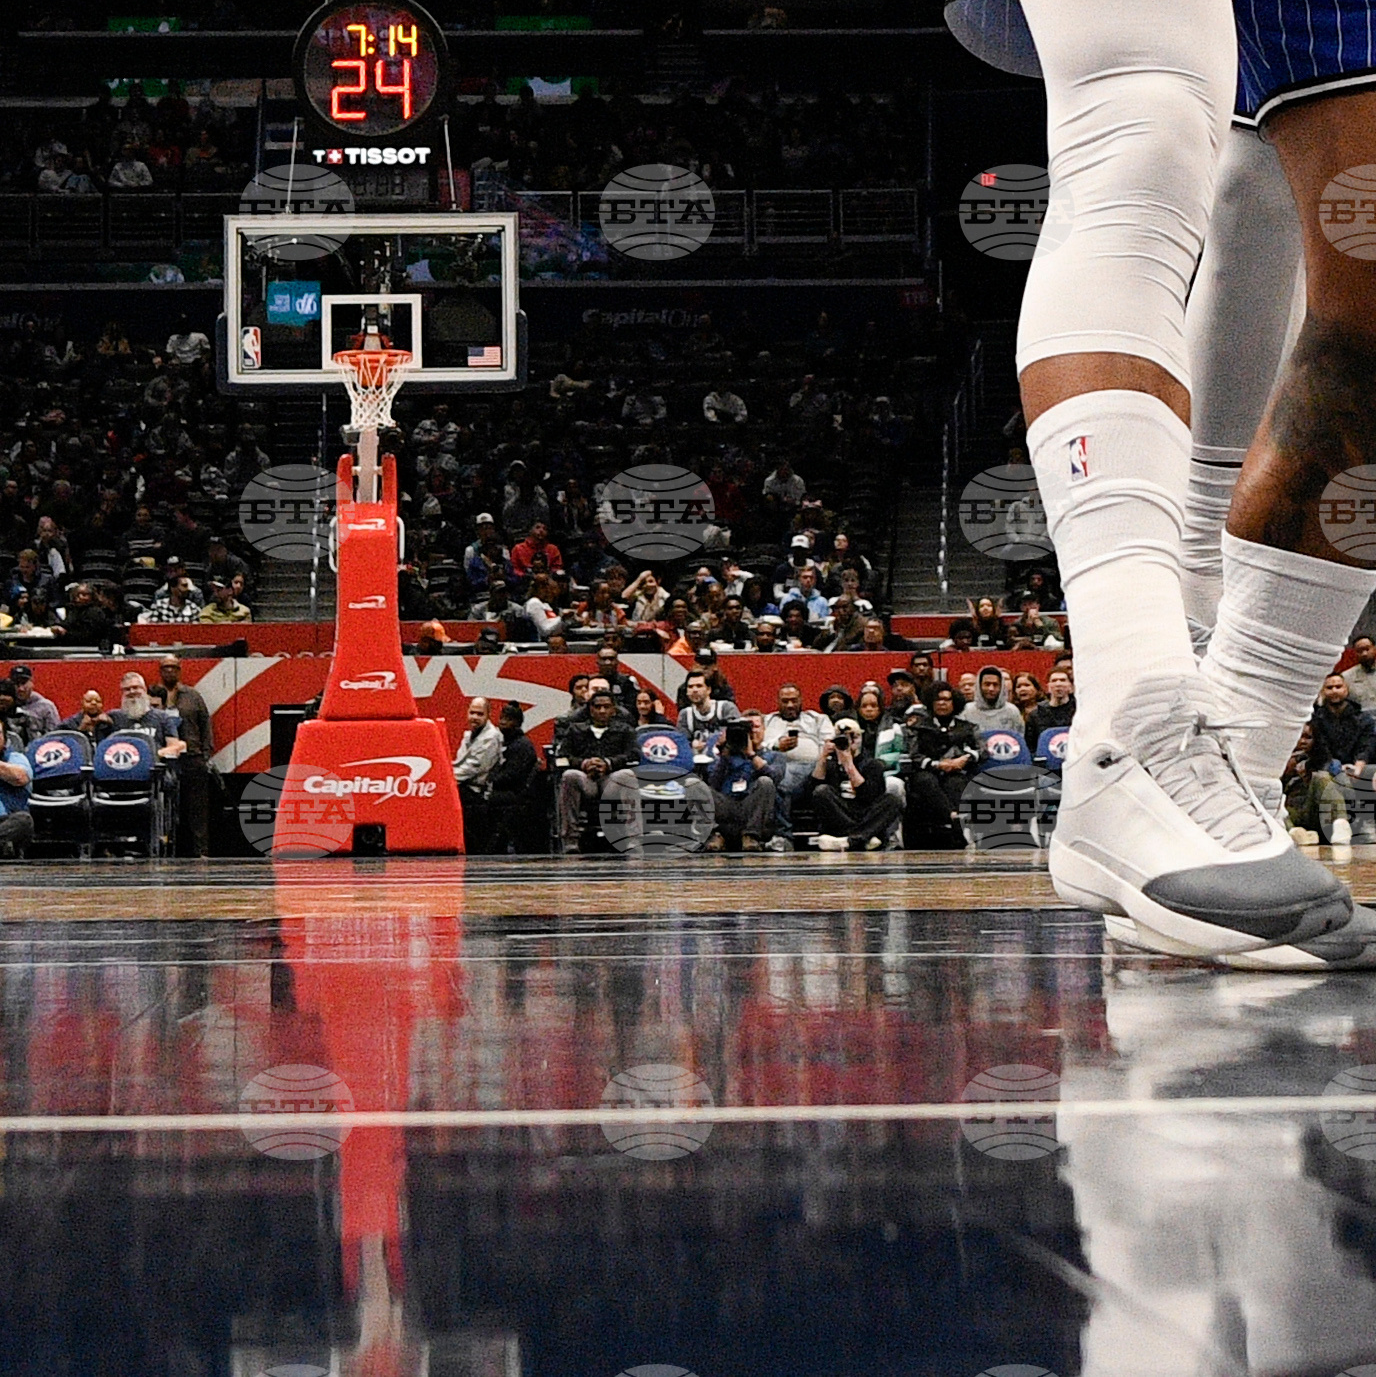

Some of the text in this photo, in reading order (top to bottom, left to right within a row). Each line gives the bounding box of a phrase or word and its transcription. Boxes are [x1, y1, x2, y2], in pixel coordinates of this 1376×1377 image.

[346, 23, 418, 58] 7:14
[331, 59, 412, 120] 24
[344, 147, 431, 165] TISSOT
